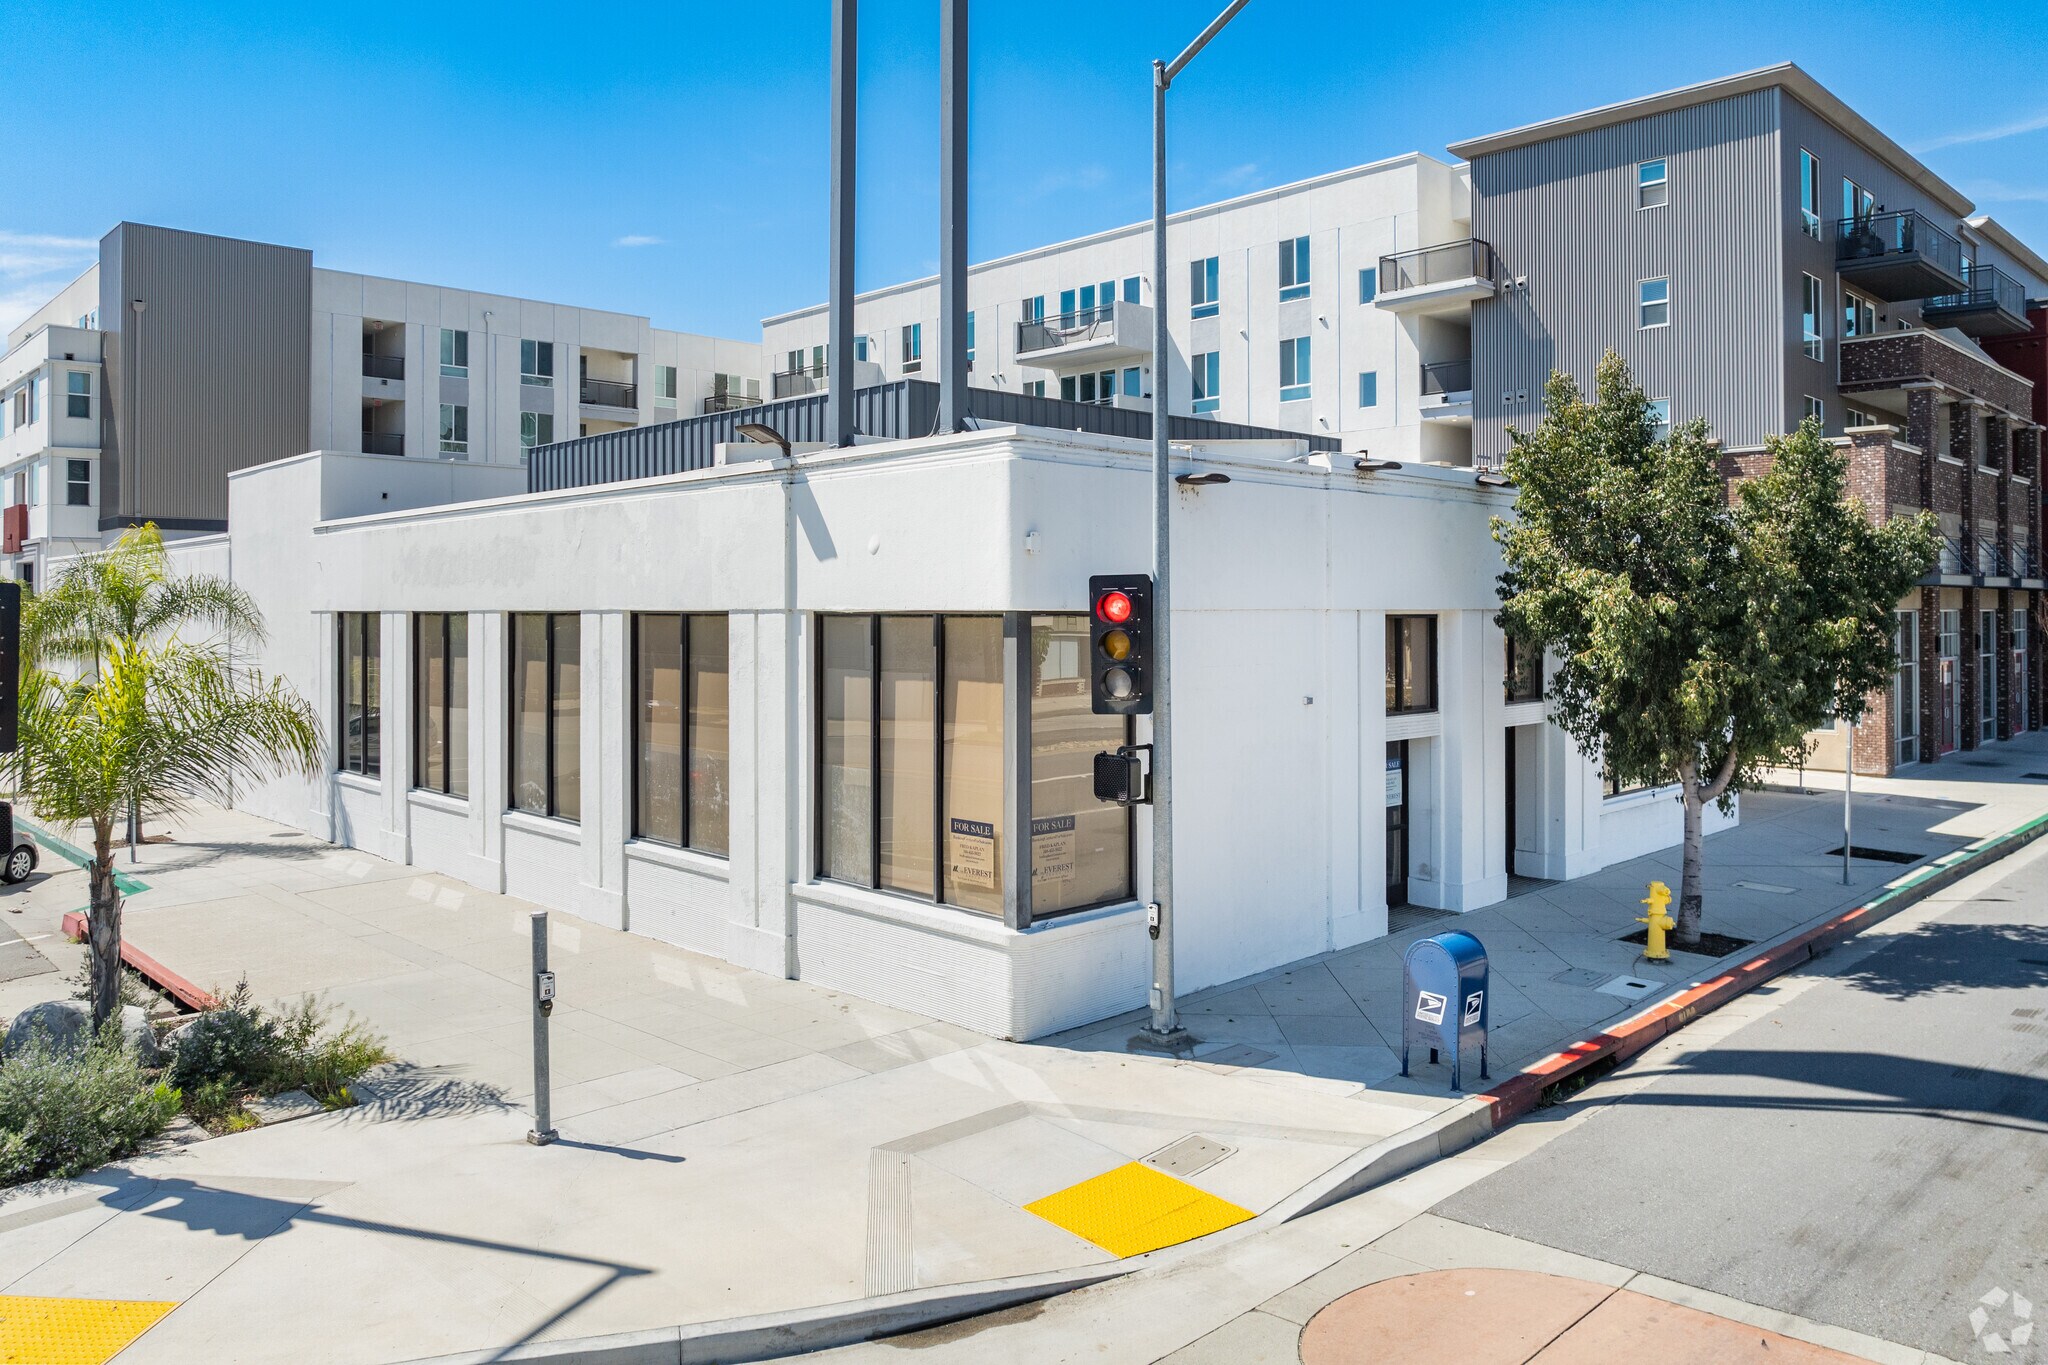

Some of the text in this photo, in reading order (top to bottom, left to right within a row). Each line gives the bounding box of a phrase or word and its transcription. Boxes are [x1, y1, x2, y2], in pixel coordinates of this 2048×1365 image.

[1388, 760, 1400, 768] SALE
[954, 822, 991, 835] FOR SALE
[1033, 818, 1072, 833] FOR SALE
[963, 867, 992, 878] EVEREST
[1044, 863, 1074, 873] EVEREST
